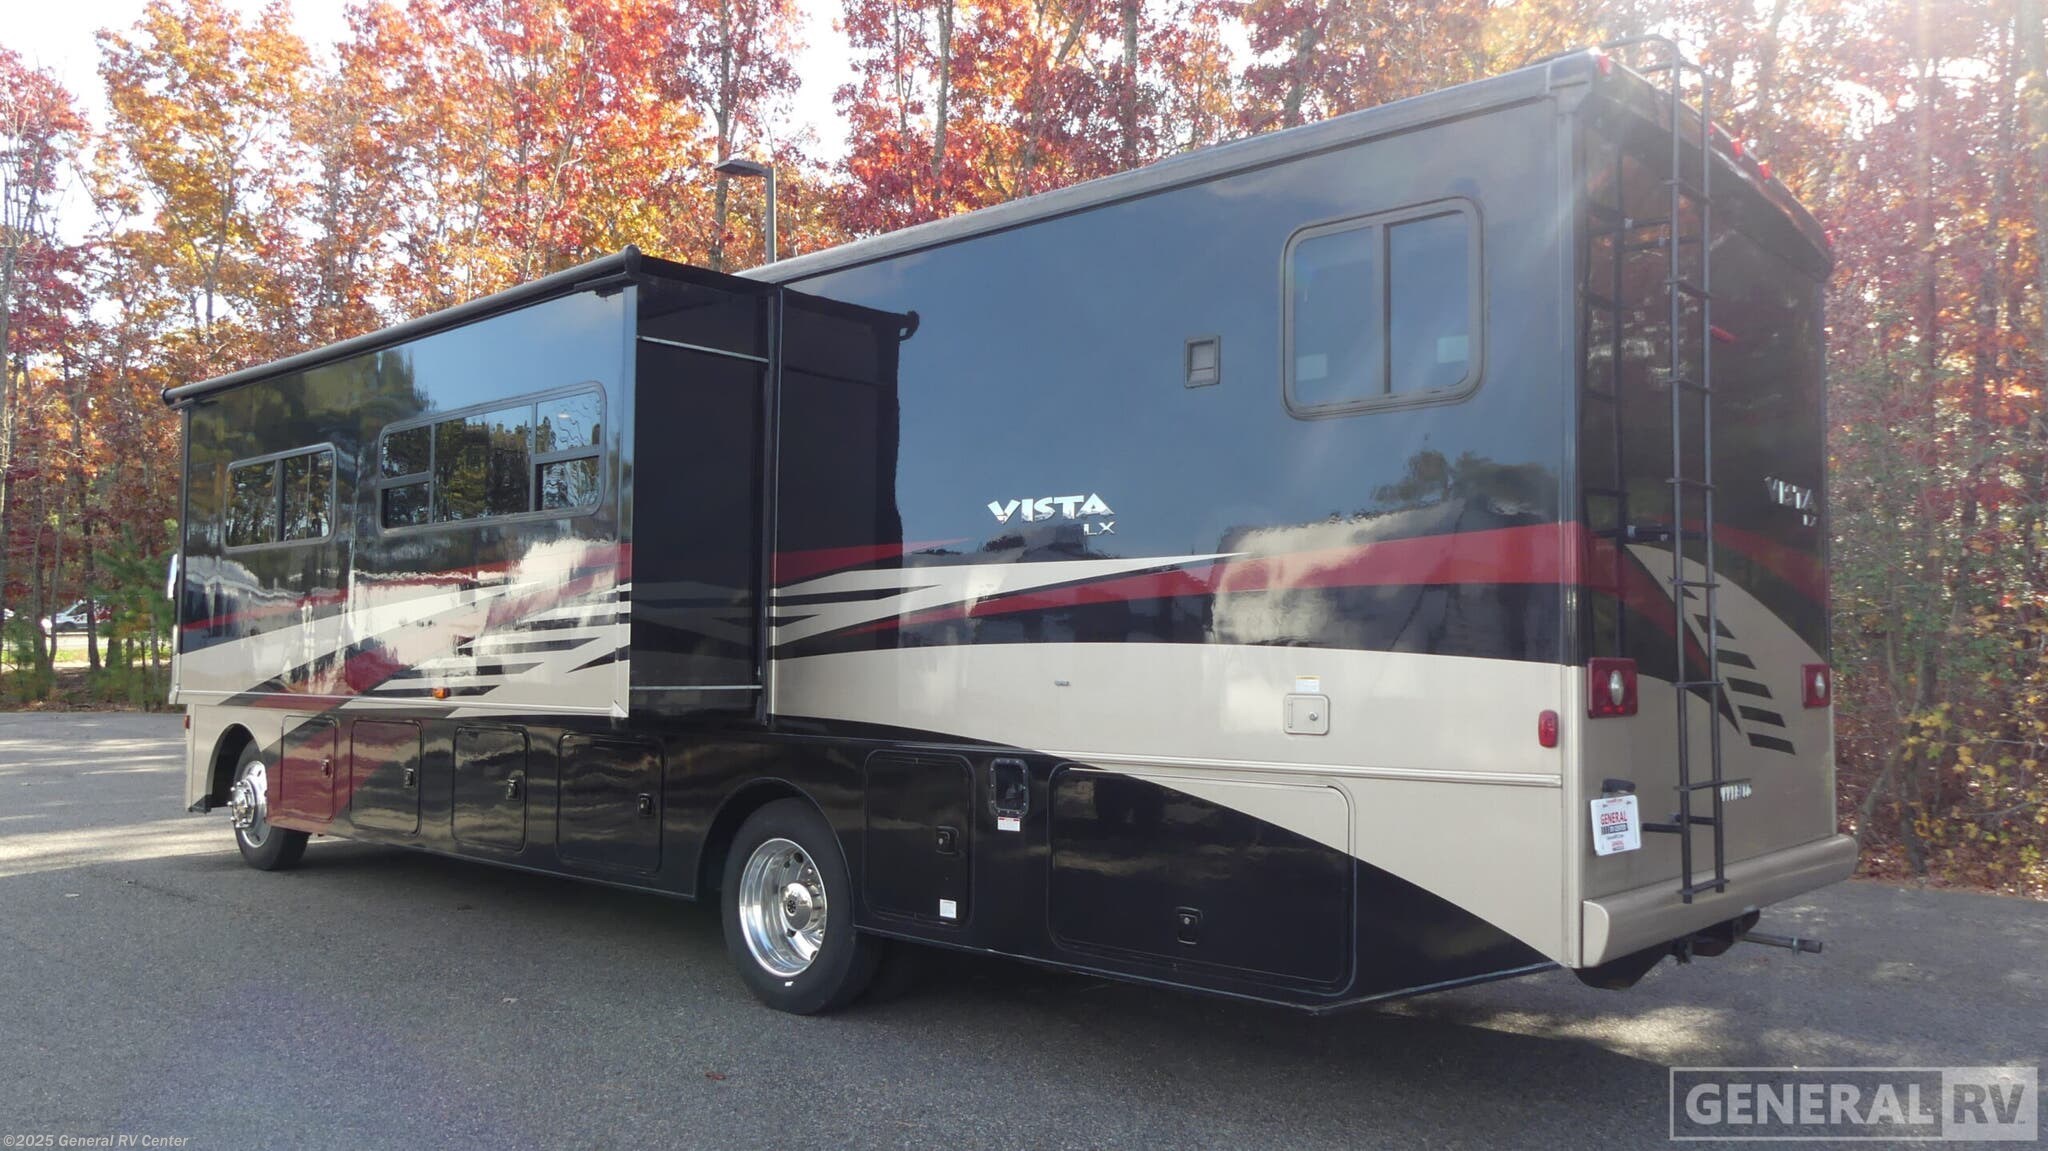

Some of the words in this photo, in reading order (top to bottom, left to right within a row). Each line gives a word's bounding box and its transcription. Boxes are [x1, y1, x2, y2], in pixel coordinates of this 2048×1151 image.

[987, 493, 1115, 524] VISTA
[1083, 521, 1115, 536] LX
[1600, 810, 1628, 825] GENERAL
